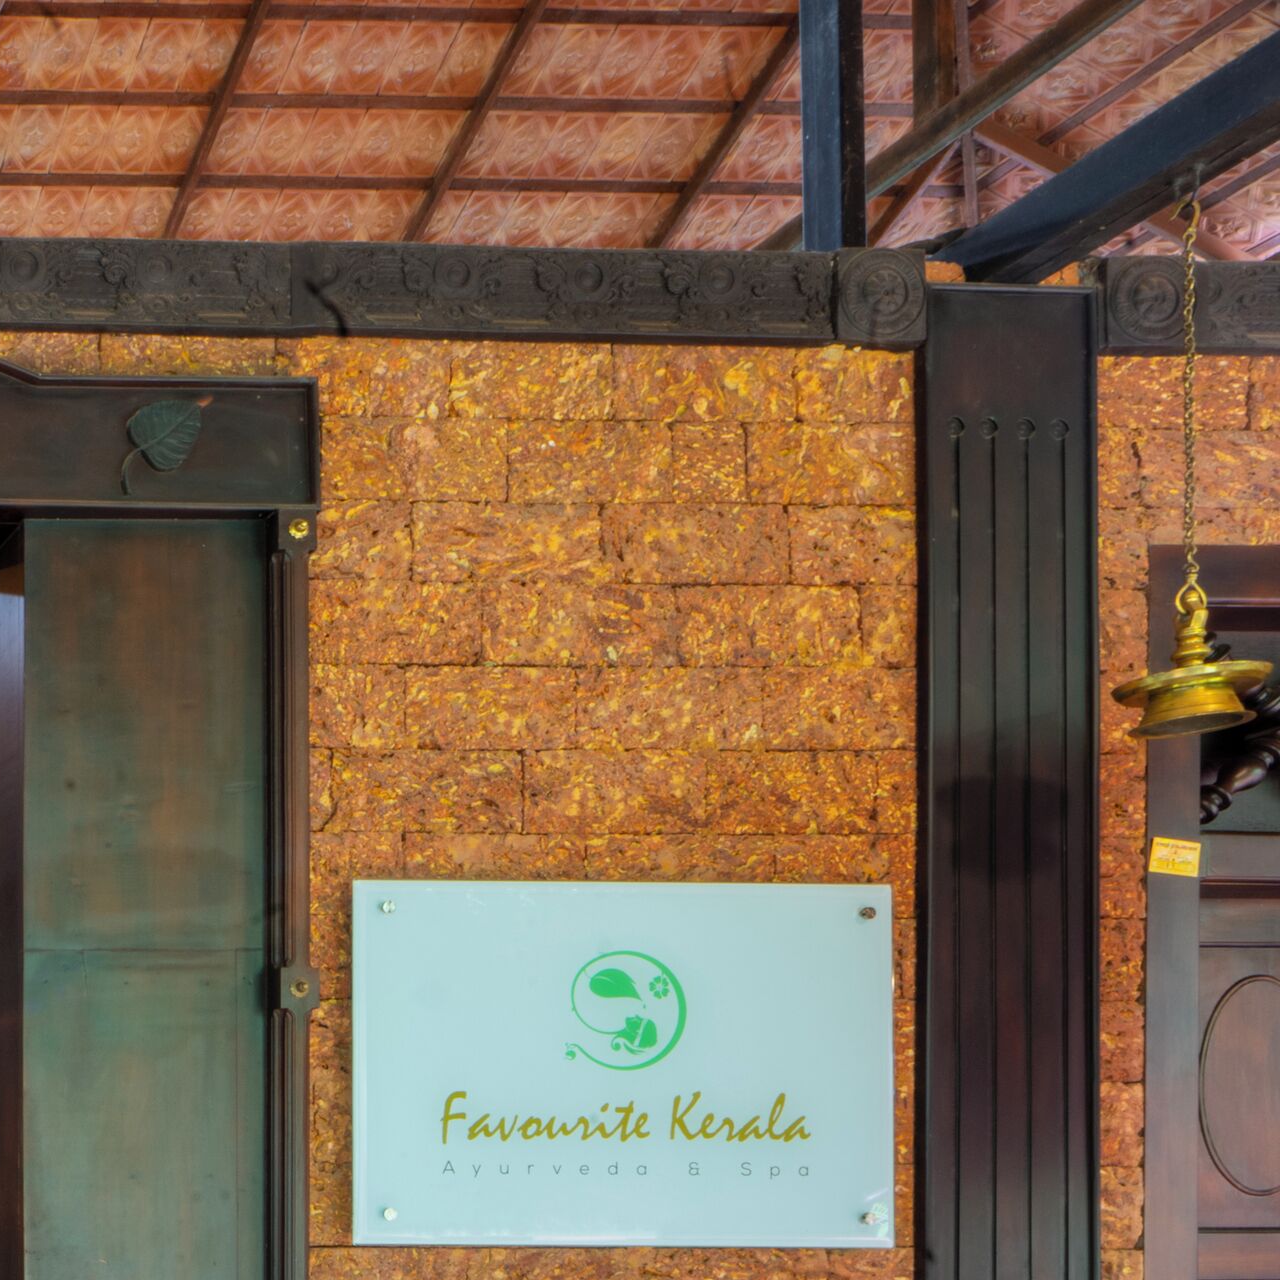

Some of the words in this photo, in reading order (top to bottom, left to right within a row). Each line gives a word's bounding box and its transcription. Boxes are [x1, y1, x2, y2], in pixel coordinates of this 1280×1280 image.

[440, 1090, 651, 1144] Favourite
[669, 1091, 812, 1143] Kerala
[441, 1159, 648, 1180] Ayurveda
[688, 1161, 701, 1177] &
[740, 1161, 811, 1181] Spa
